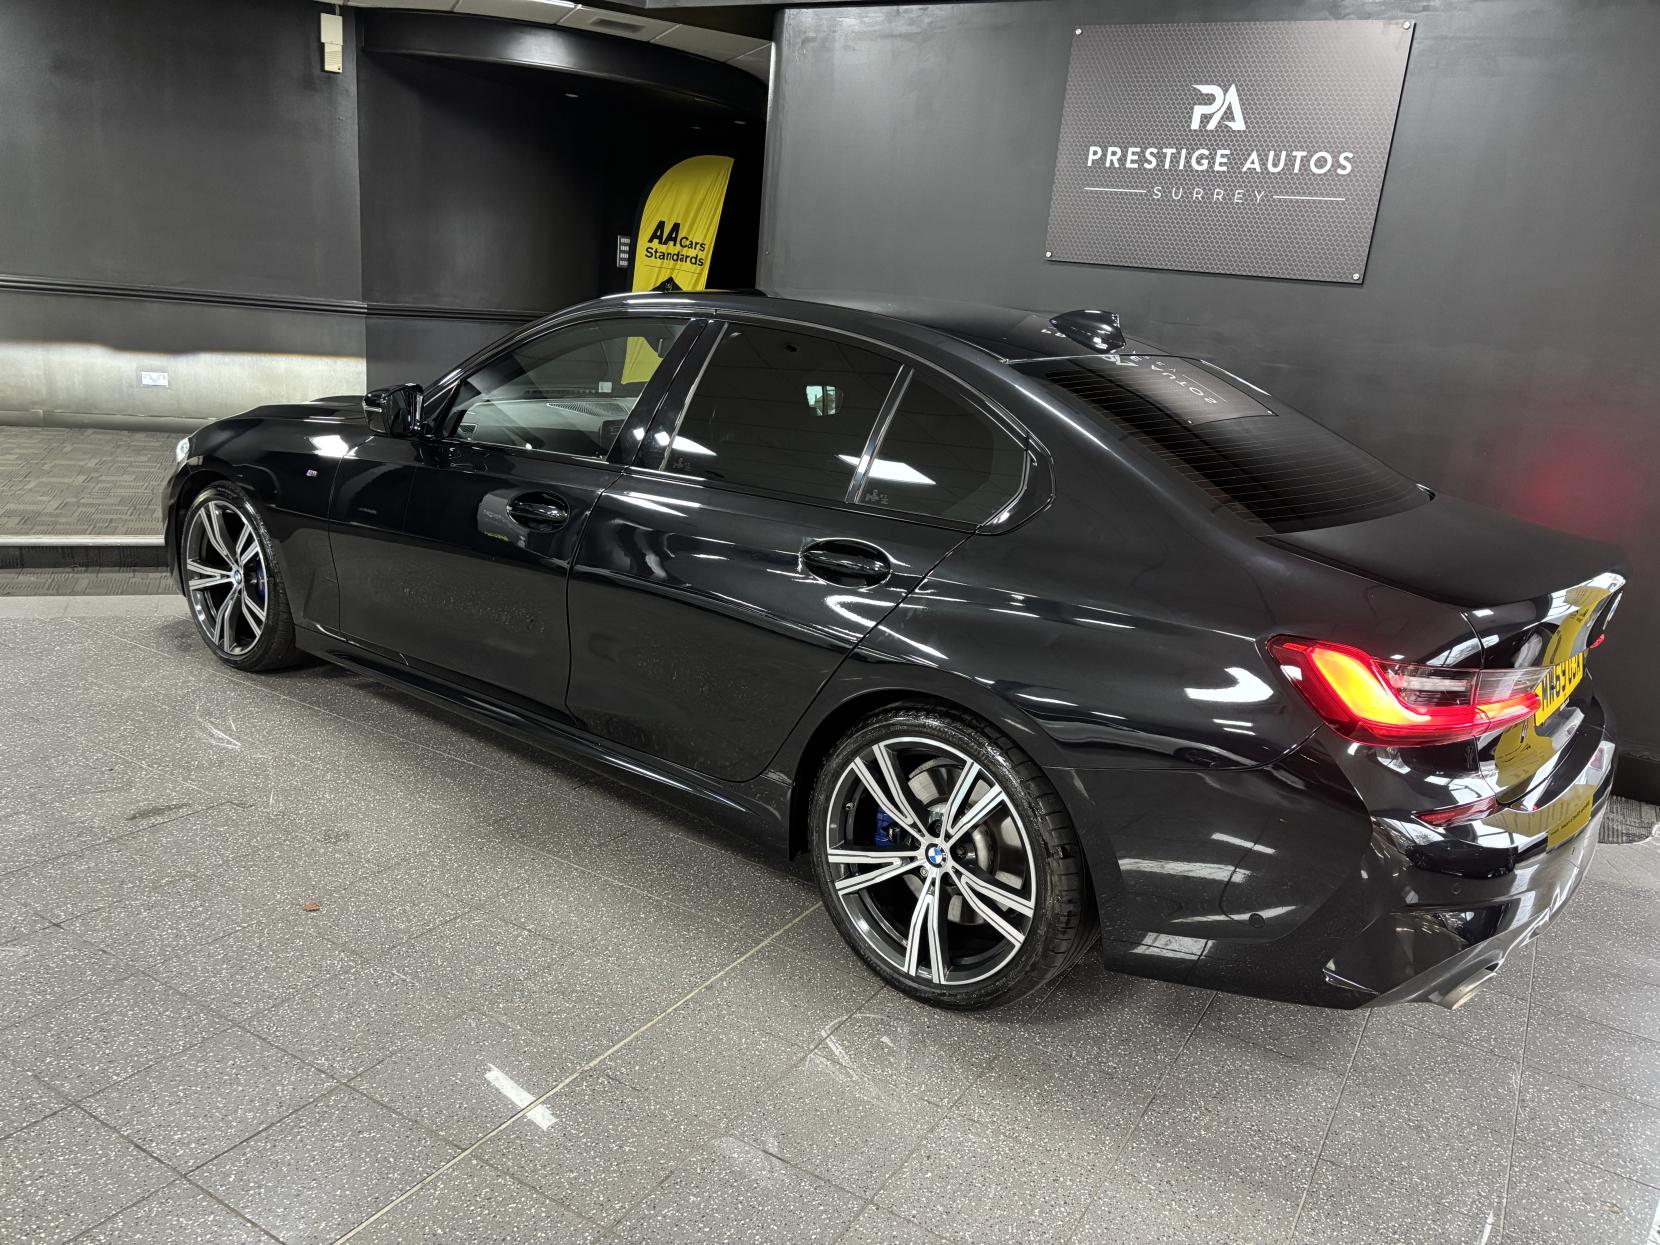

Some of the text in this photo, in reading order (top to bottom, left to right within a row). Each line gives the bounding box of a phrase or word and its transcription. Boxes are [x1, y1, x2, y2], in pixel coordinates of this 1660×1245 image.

[1191, 83, 1247, 131] PA
[1086, 145, 1354, 176] PRESTIGE AUTOS
[1152, 185, 1266, 204] SURREY
[647, 220, 706, 252] AA Cars
[644, 246, 705, 267] Standards
